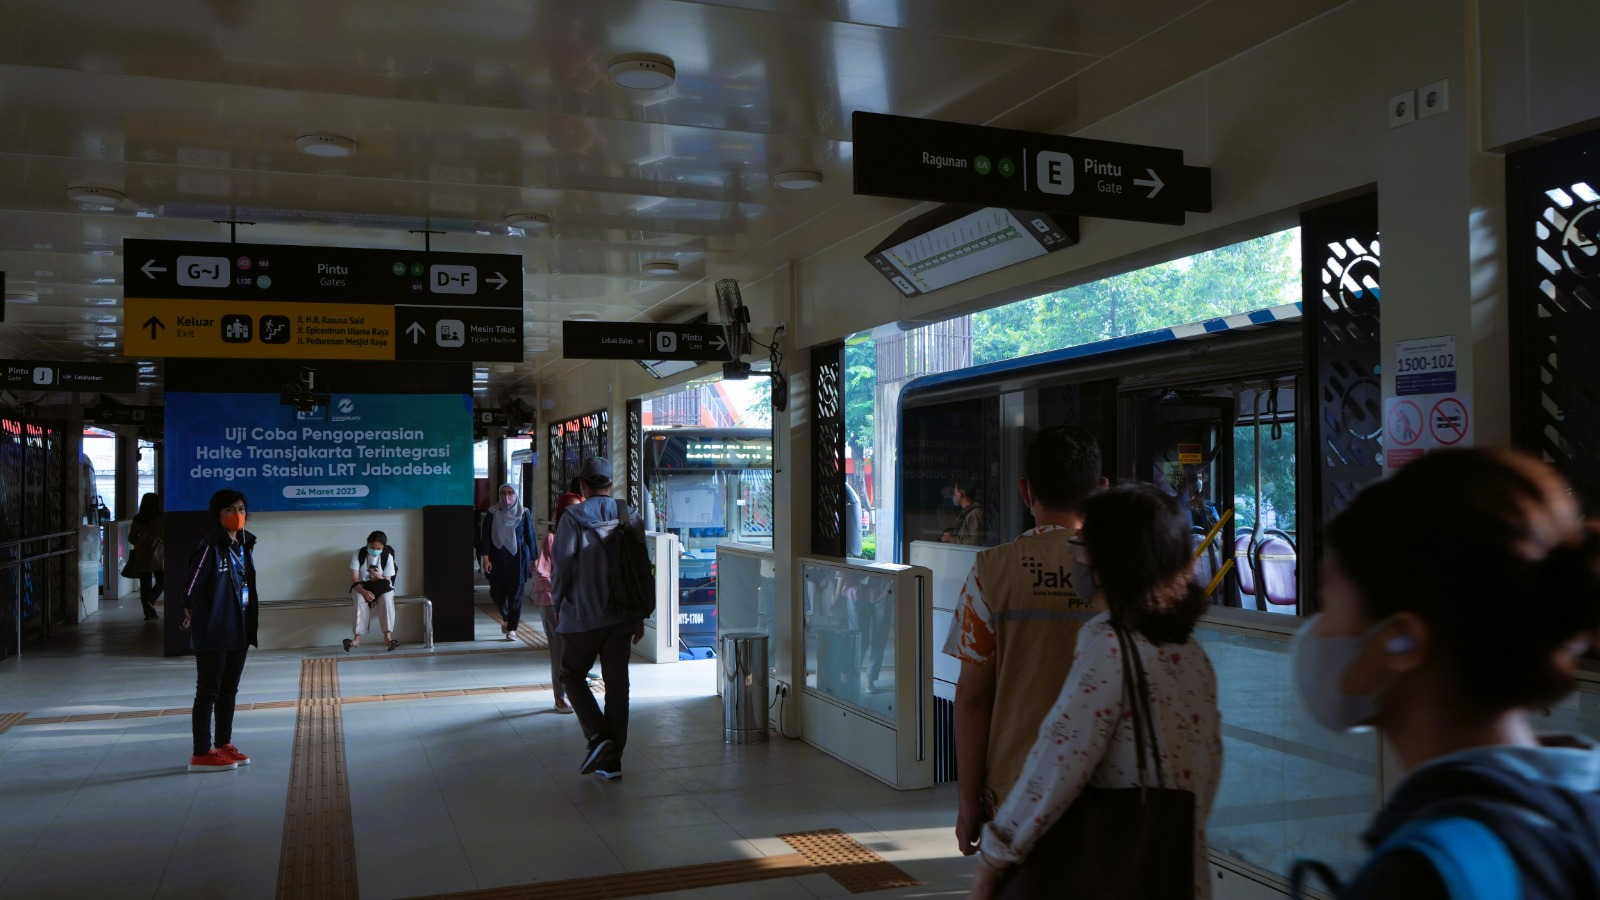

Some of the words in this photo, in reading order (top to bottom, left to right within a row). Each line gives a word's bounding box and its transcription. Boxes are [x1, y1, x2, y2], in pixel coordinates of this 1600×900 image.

[922, 151, 968, 169] Ragunan
[976, 160, 988, 169] 6A
[1003, 163, 1009, 172] 6
[1049, 160, 1062, 185] E
[1084, 158, 1122, 177] Pintu
[1097, 179, 1123, 194] Gate
[187, 264, 220, 280] G~J
[317, 263, 349, 276] Pintu
[320, 278, 346, 288] Gates
[438, 272, 470, 287] D~F
[176, 316, 214, 327] Keluar
[306, 316, 320, 324] H.R.
[321, 316, 348, 324] Rasuna
[349, 316, 364, 325] Said
[177, 330, 195, 338] Exit
[306, 326, 346, 337] Epicentrum
[347, 327, 370, 336] Utama
[370, 328, 389, 338] Raya
[470, 324, 494, 334] Mesin
[495, 325, 516, 334] Tiket
[306, 337, 344, 346] Pedurenan
[345, 338, 370, 348] Mesjid
[370, 338, 388, 348] Raya
[490, 336, 517, 344] Machine
[662, 336, 671, 347] D
[682, 334, 703, 342] Pintu
[1398, 354, 1454, 372] 1500-102
[8, 367, 29, 375] Pintu
[40, 371, 44, 381] J
[225, 427, 247, 444] Uji
[251, 427, 298, 440] Coba
[302, 427, 424, 444] Pengoperasian
[196, 446, 243, 460] Halte
[247, 445, 352, 462] Transjakarta
[356, 444, 450, 460] Terintegrasi
[190, 464, 257, 481] dengan
[262, 464, 324, 477] Stasiun
[328, 463, 357, 477] LRT
[361, 462, 452, 476] Jabodebek
[296, 488, 306, 496] 24
[308, 488, 334, 496] Maret
